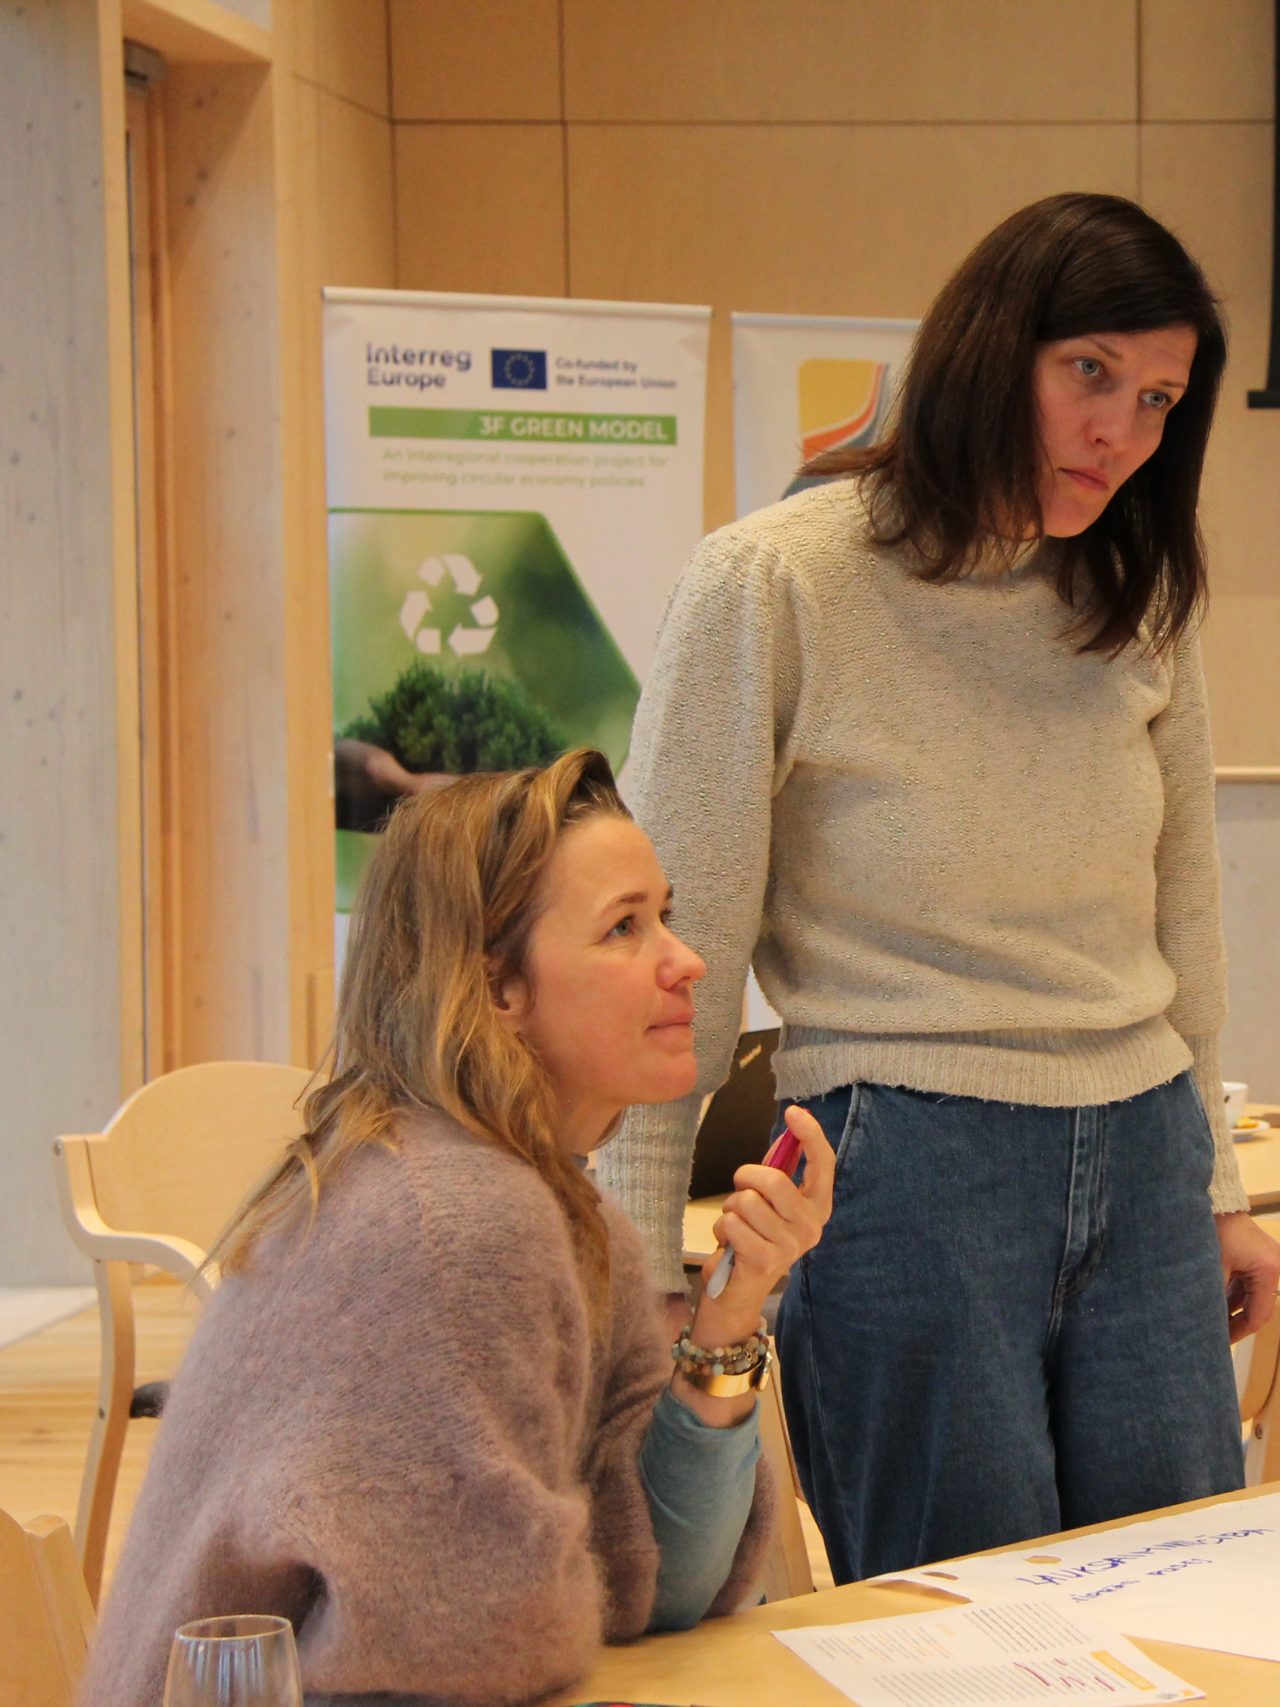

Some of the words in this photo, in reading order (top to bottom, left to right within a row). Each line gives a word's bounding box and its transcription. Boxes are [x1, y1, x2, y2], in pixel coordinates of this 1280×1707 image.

[367, 342, 472, 372] Interreg
[555, 356, 620, 370] Co-funded
[622, 359, 639, 374] by
[367, 367, 447, 391] Europe
[555, 374, 575, 385] the
[578, 375, 637, 388] European
[640, 377, 677, 389] Union
[479, 415, 506, 435] 3F
[509, 415, 584, 437] GREEN
[588, 419, 669, 440] MODEL
[504, 453, 590, 468] cooperation
[593, 454, 645, 470] project
[648, 454, 671, 467] for
[461, 473, 516, 486] circular
[519, 475, 588, 490] economy
[590, 474, 646, 489] policies
